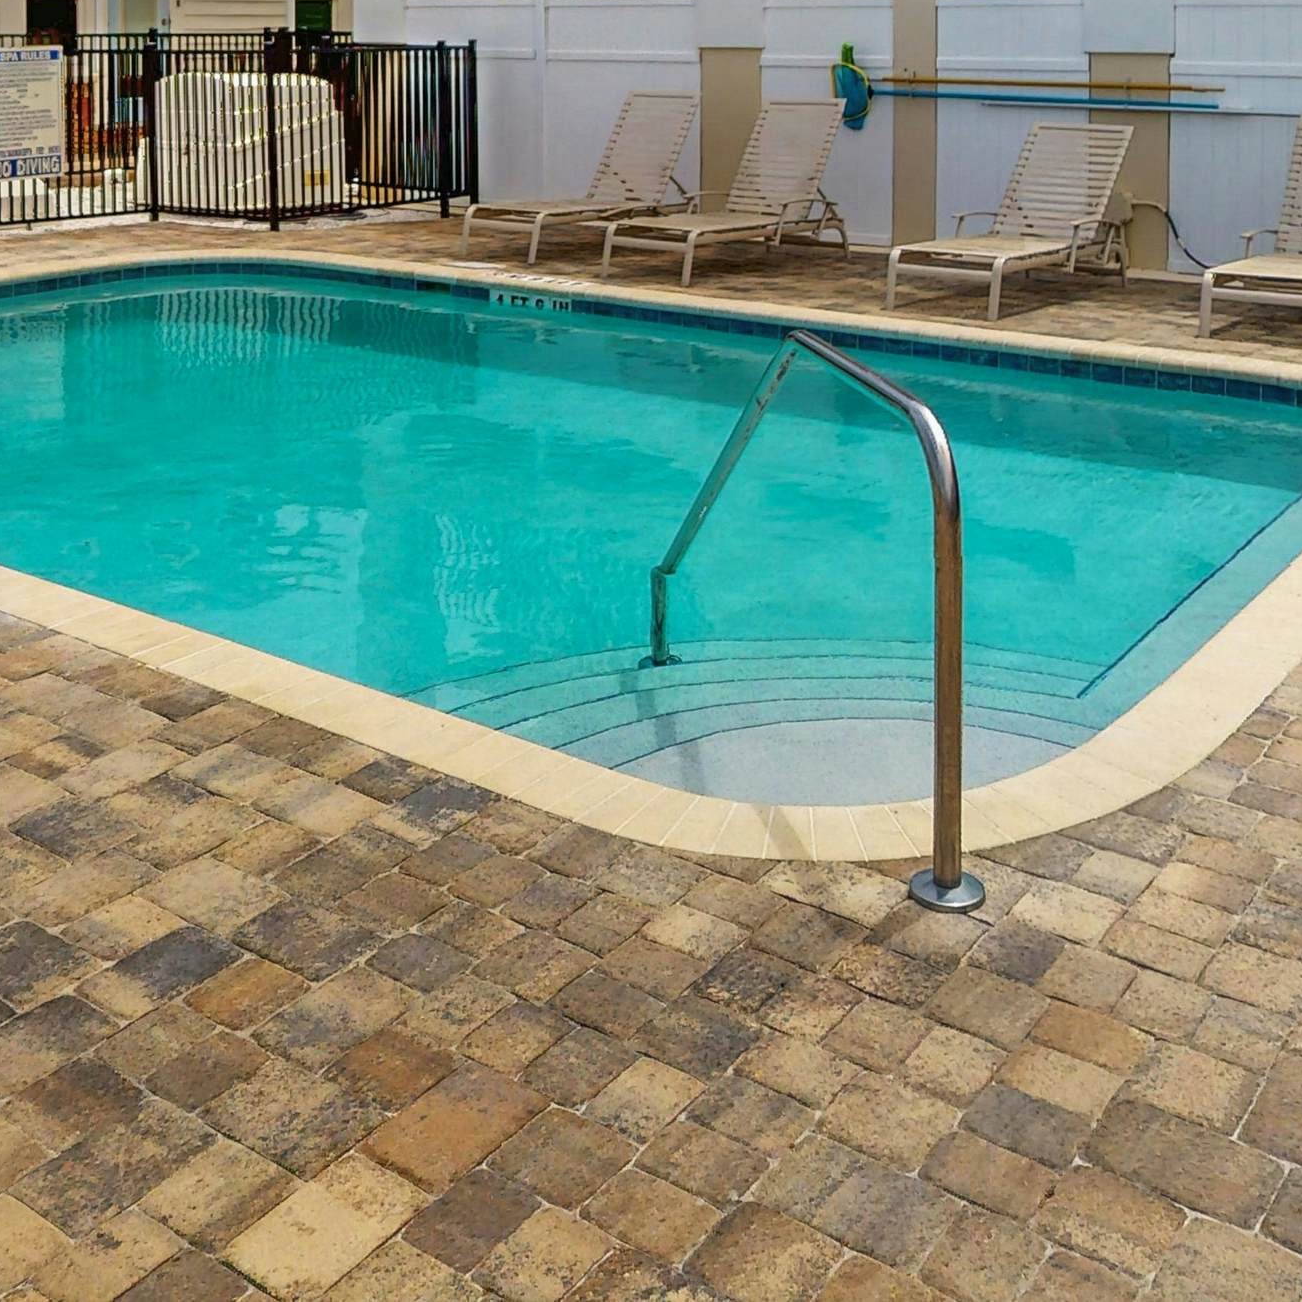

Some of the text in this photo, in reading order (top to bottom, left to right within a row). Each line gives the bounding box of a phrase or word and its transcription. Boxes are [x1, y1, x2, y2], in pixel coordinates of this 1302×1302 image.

[0, 50, 51, 62] SPA RULES
[16, 156, 60, 176] DIVING
